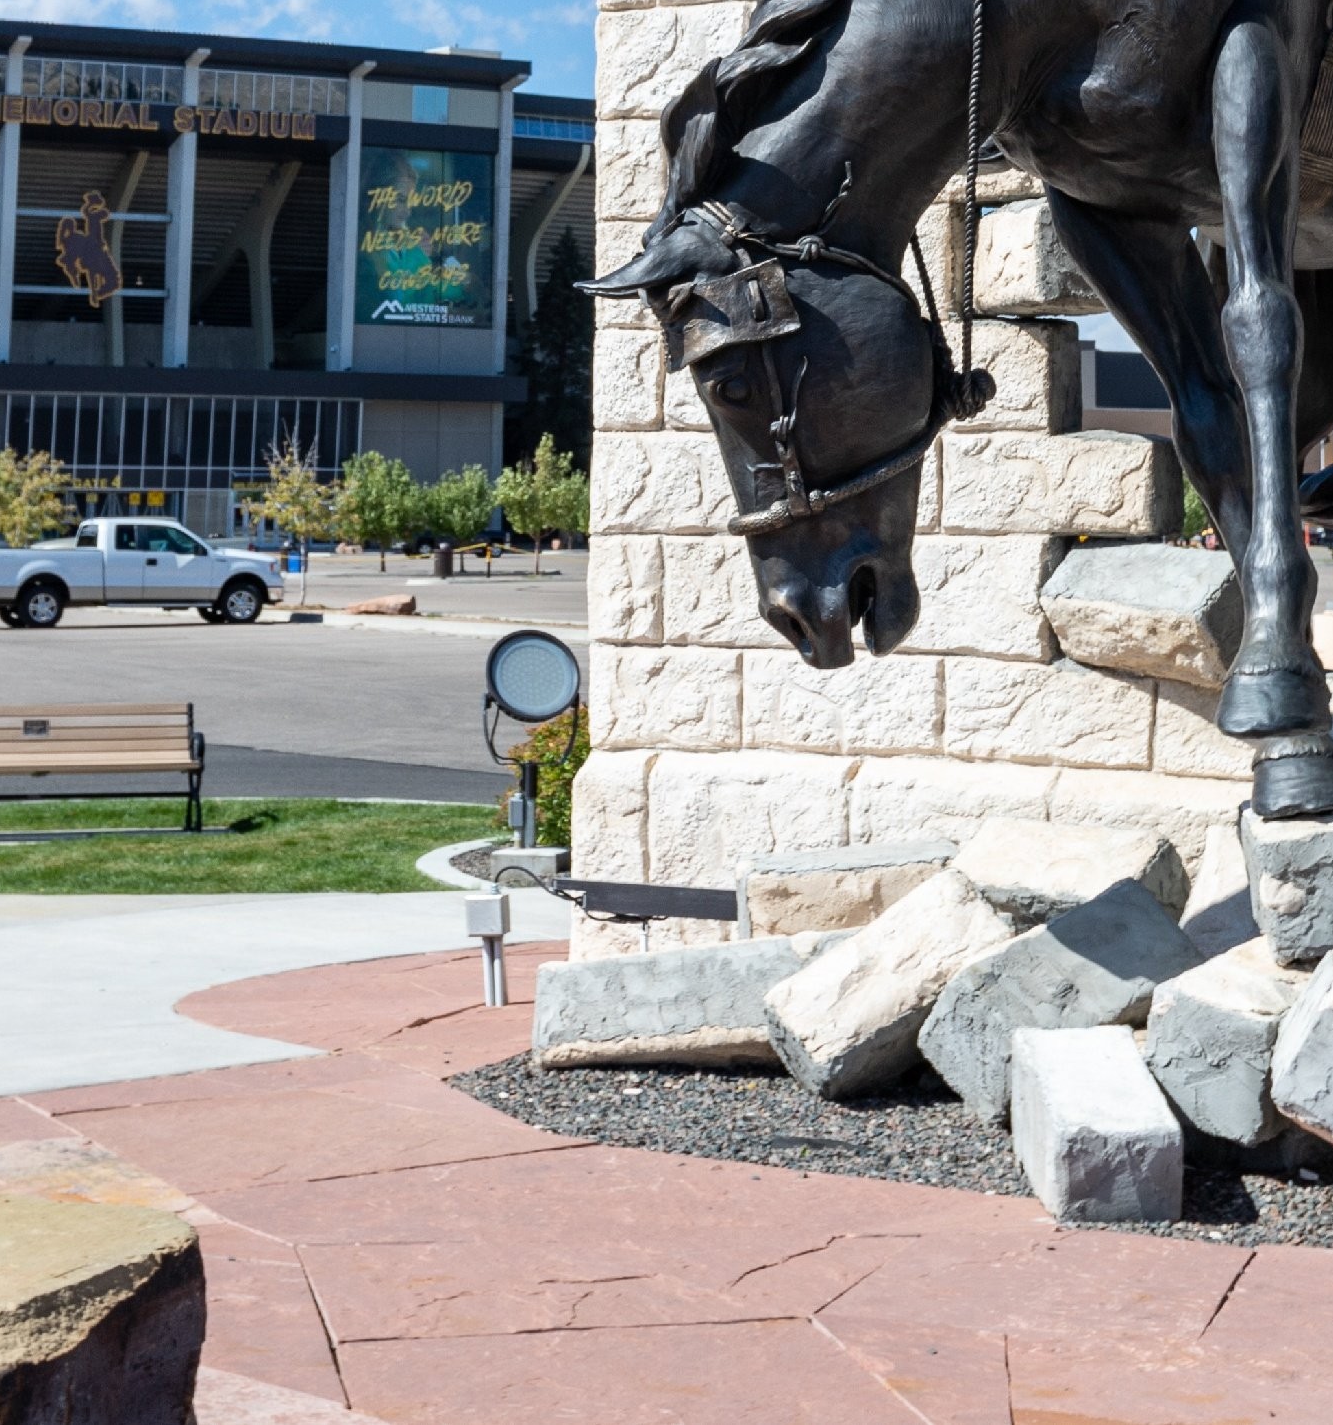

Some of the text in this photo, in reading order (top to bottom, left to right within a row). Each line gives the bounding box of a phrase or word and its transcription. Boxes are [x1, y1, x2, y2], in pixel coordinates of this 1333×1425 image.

[173, 105, 316, 141] STADIUM
[368, 181, 473, 221] THE WORLD
[361, 222, 486, 253] NEEDS MORE
[379, 263, 470, 292] COWBOYS
[403, 303, 448, 314] WESTERN
[413, 314, 475, 325] STATES BANK
[73, 478, 108, 488] GATE
